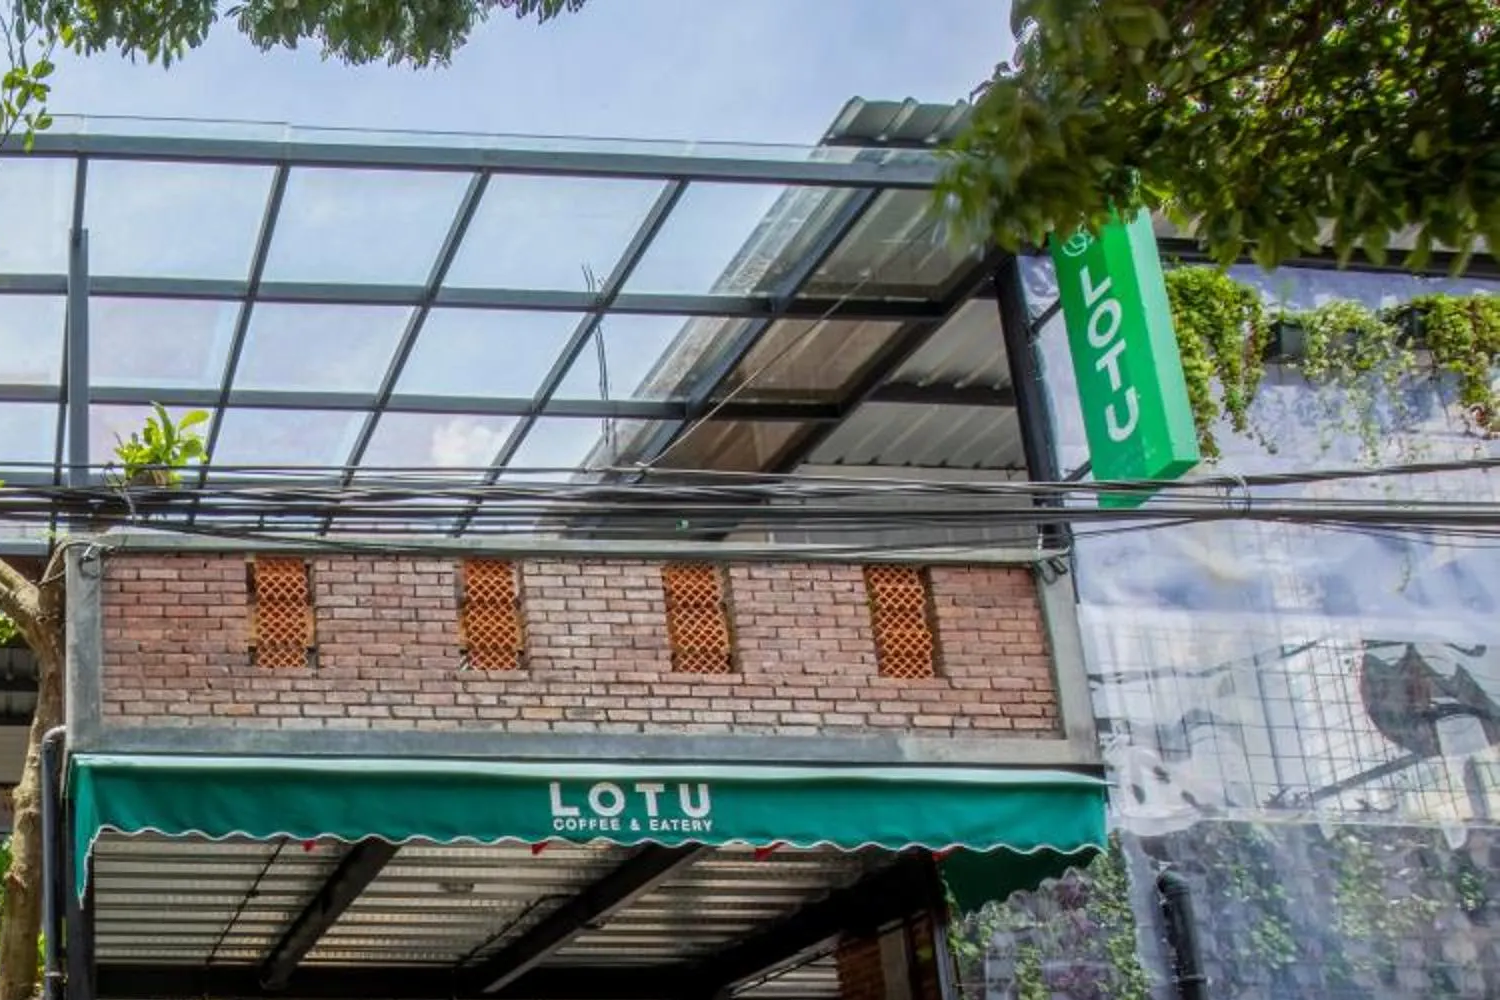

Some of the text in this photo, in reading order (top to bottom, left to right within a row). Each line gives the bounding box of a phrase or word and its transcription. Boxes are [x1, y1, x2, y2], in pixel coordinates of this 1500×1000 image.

[1080, 265, 1139, 442] LOTU
[550, 782, 711, 817] LOTU
[553, 818, 713, 831] COFFEE & EATERY
